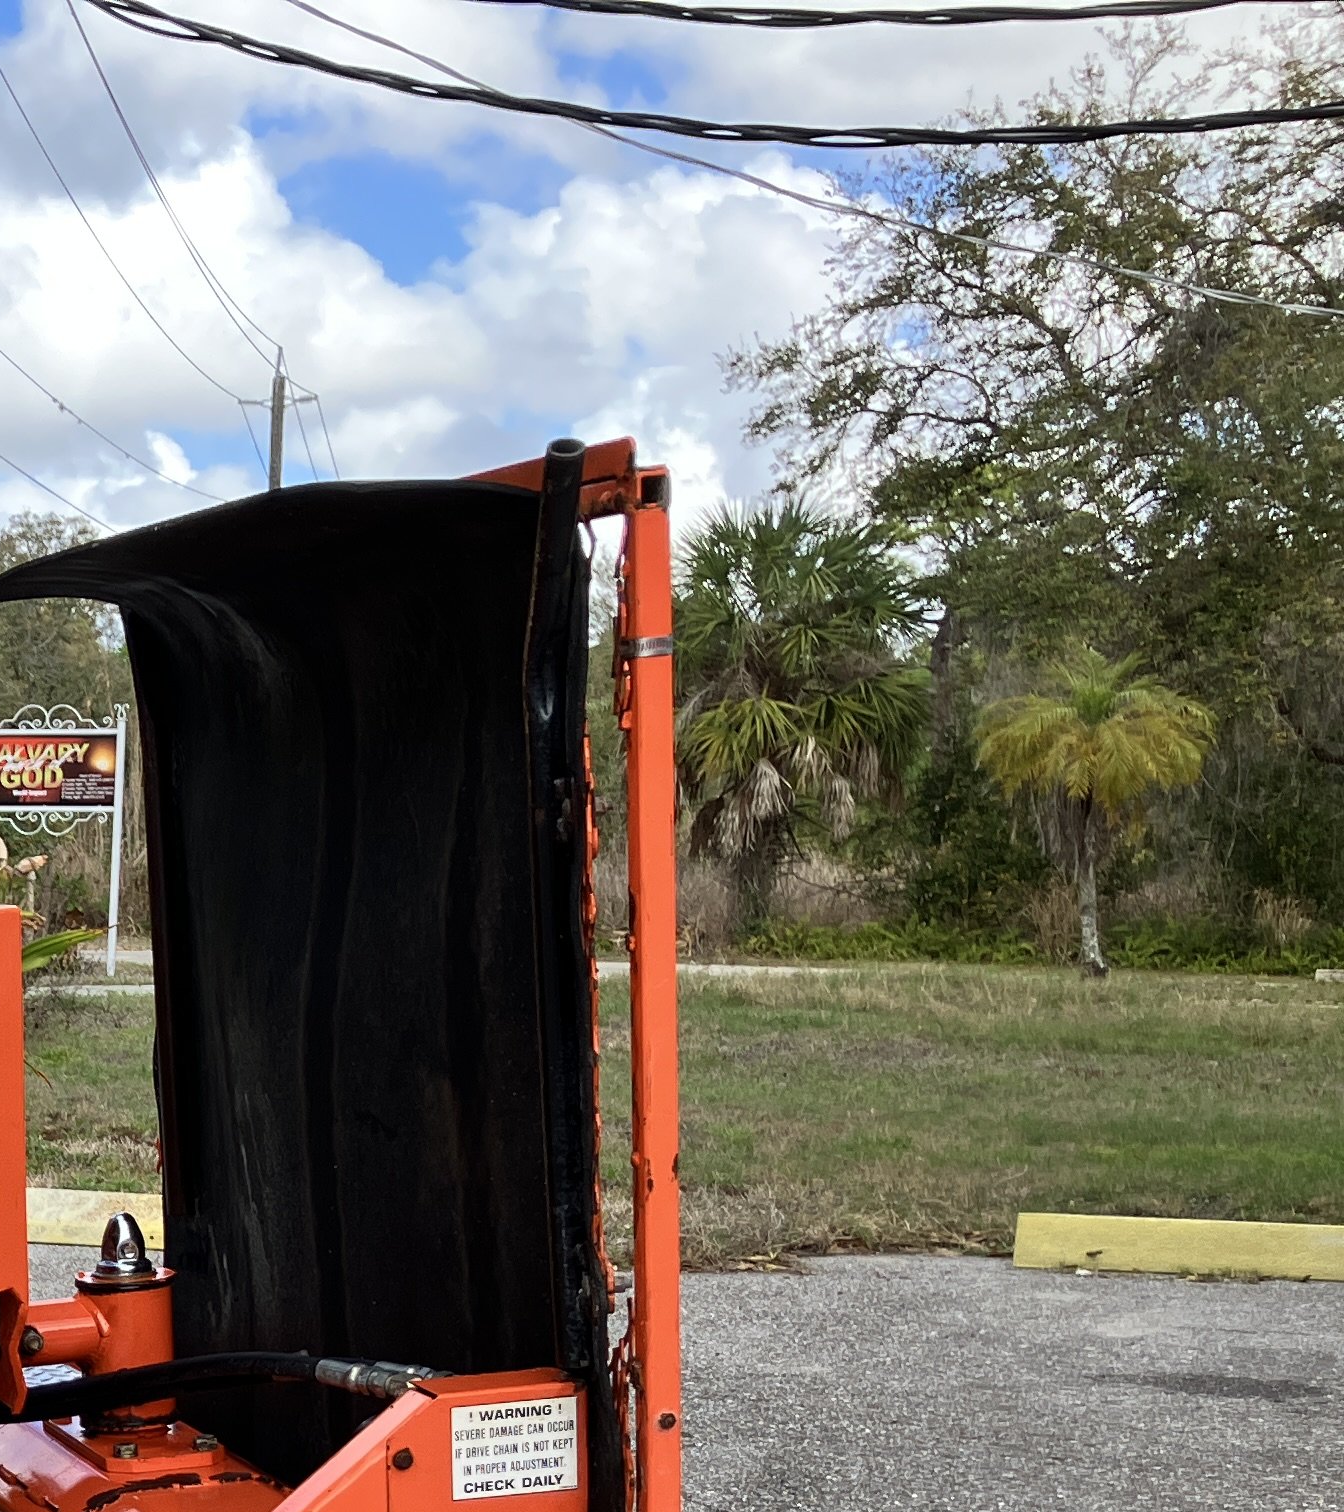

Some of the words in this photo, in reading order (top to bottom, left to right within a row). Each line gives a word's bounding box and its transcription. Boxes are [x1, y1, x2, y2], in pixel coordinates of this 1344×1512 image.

[0, 765, 64, 790] GOD
[479, 1404, 552, 1422] WARNING
[454, 1427, 486, 1442] SEVERE
[489, 1424, 524, 1438] DAMAGE
[527, 1422, 544, 1435] CAN
[547, 1419, 575, 1433] OCCUR
[455, 1448, 464, 1460] IF
[465, 1445, 491, 1459] DRIVE
[493, 1442, 519, 1456] CHAIN
[521, 1441, 530, 1453] IS
[533, 1439, 550, 1452] NOT
[552, 1437, 574, 1450] KEPT
[463, 1465, 472, 1477] IN
[475, 1461, 507, 1475] PROPER
[463, 1478, 515, 1494] CHECK
[521, 1473, 565, 1489] DAILY
